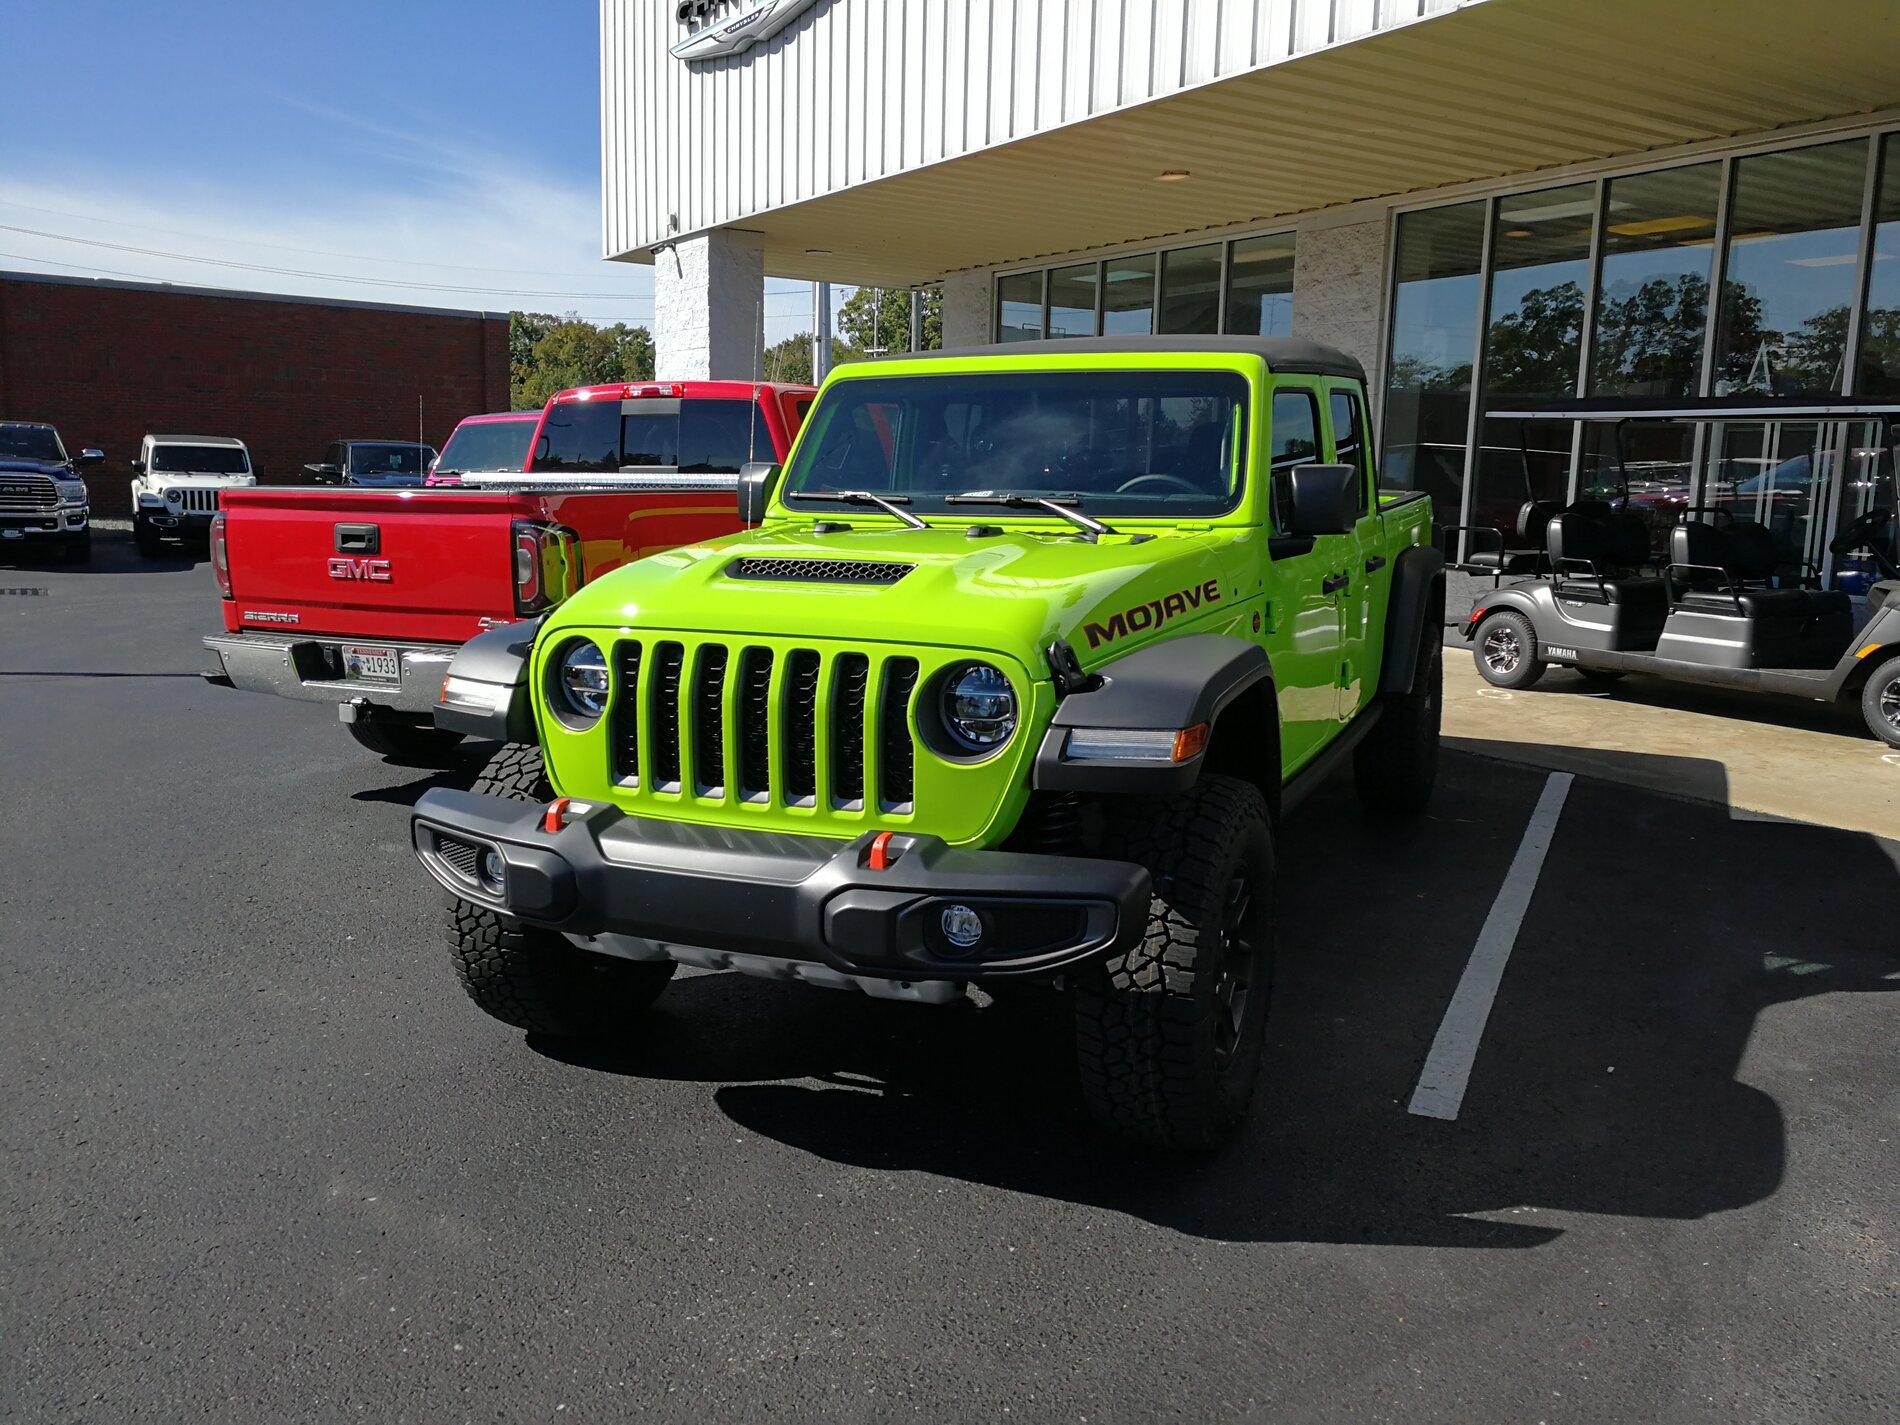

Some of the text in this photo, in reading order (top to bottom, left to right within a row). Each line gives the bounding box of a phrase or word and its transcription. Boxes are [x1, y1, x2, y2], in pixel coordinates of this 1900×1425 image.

[727, 12, 760, 33] CHRYSLER
[326, 557, 391, 580] GMC
[244, 611, 299, 623] SIERRA
[1083, 579, 1221, 648] MOJAVE
[1547, 646, 1577, 660] YAMAHA
